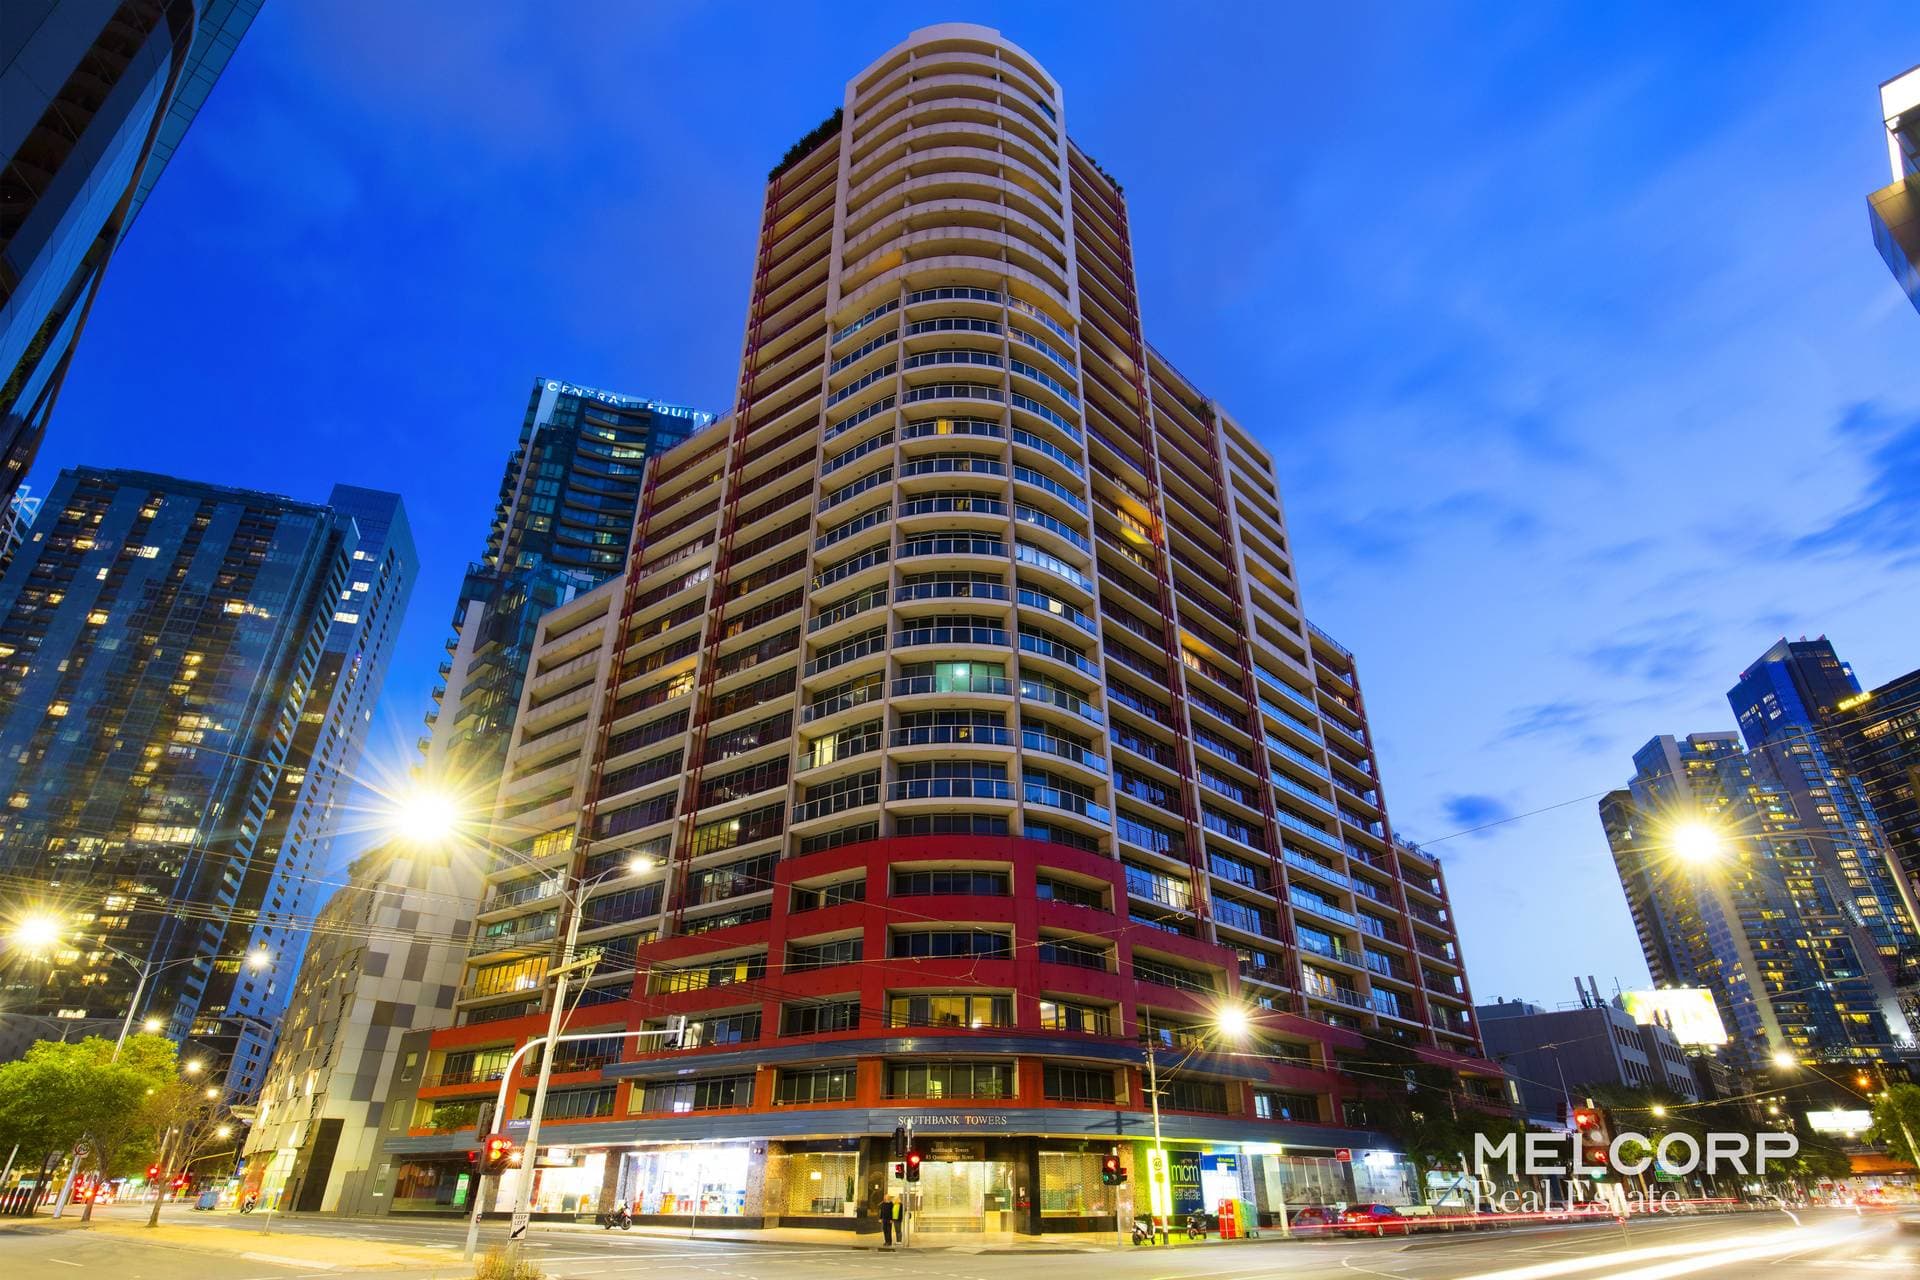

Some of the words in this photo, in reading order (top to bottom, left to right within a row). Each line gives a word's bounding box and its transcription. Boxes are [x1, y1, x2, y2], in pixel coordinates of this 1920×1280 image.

[647, 402, 710, 423] EQUITY
[898, 1115, 960, 1126] SOUTHBANK
[964, 1115, 1007, 1125] TOWERS
[1170, 1165, 1199, 1182] micm
